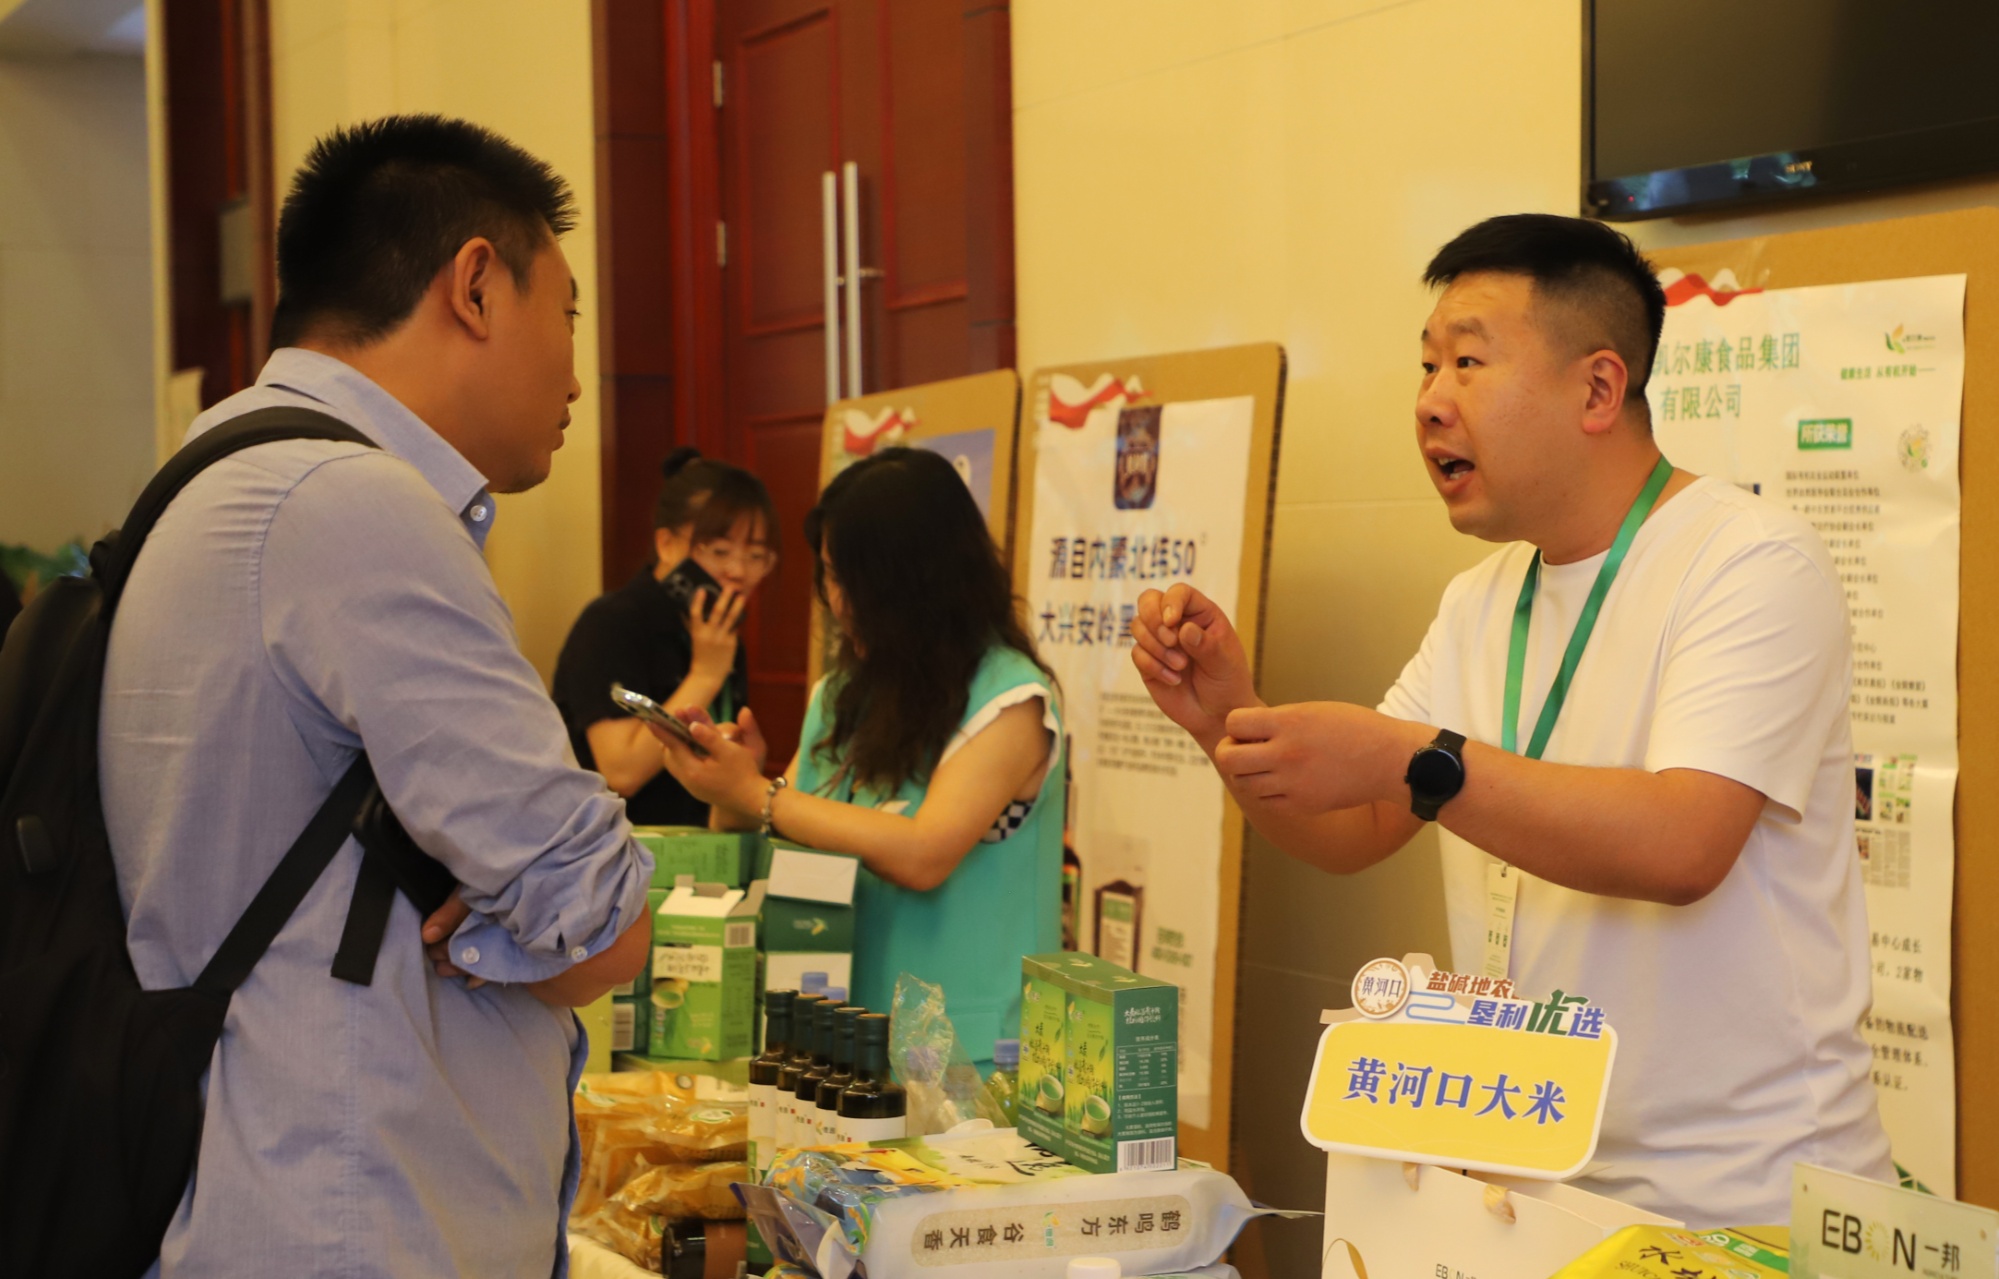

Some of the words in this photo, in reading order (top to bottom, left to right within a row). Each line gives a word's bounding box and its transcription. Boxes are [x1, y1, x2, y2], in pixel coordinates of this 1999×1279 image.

[1659, 383, 1742, 421] 有限公司
[1361, 976, 1403, 998] 黄河口
[1426, 971, 1520, 1000] 盐碱地农
[1466, 989, 1607, 1040] 垦利优选
[1342, 1056, 1567, 1125] 黄河口大米
[924, 1222, 1026, 1251] 谷食天香
[1081, 1209, 1181, 1237] 鹤鸣东方
[1924, 1241, 1961, 1273] 一邦
